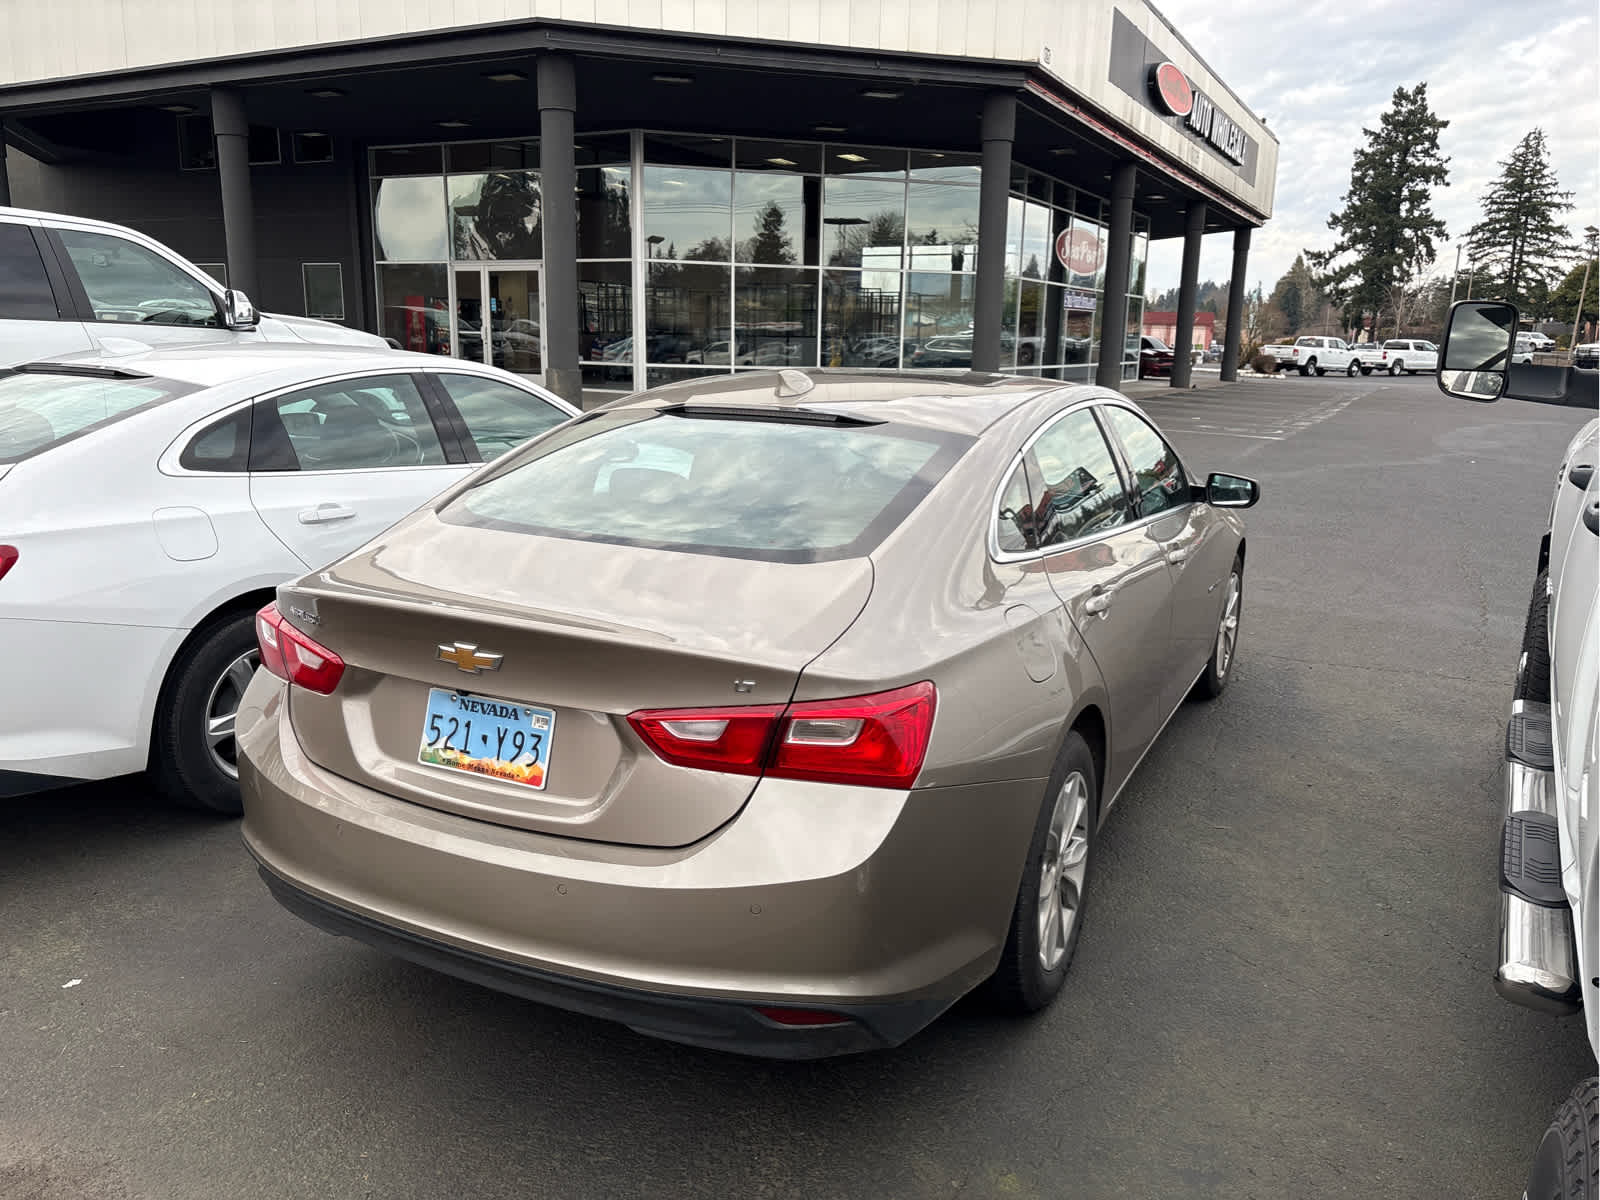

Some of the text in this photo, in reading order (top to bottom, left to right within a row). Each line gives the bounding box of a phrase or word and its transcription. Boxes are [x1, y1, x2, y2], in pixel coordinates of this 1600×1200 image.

[1190, 91, 1212, 138] AUTO
[458, 698, 520, 721] NEVADA
[446, 760, 465, 769] Home
[490, 767, 515, 779] Nevada
